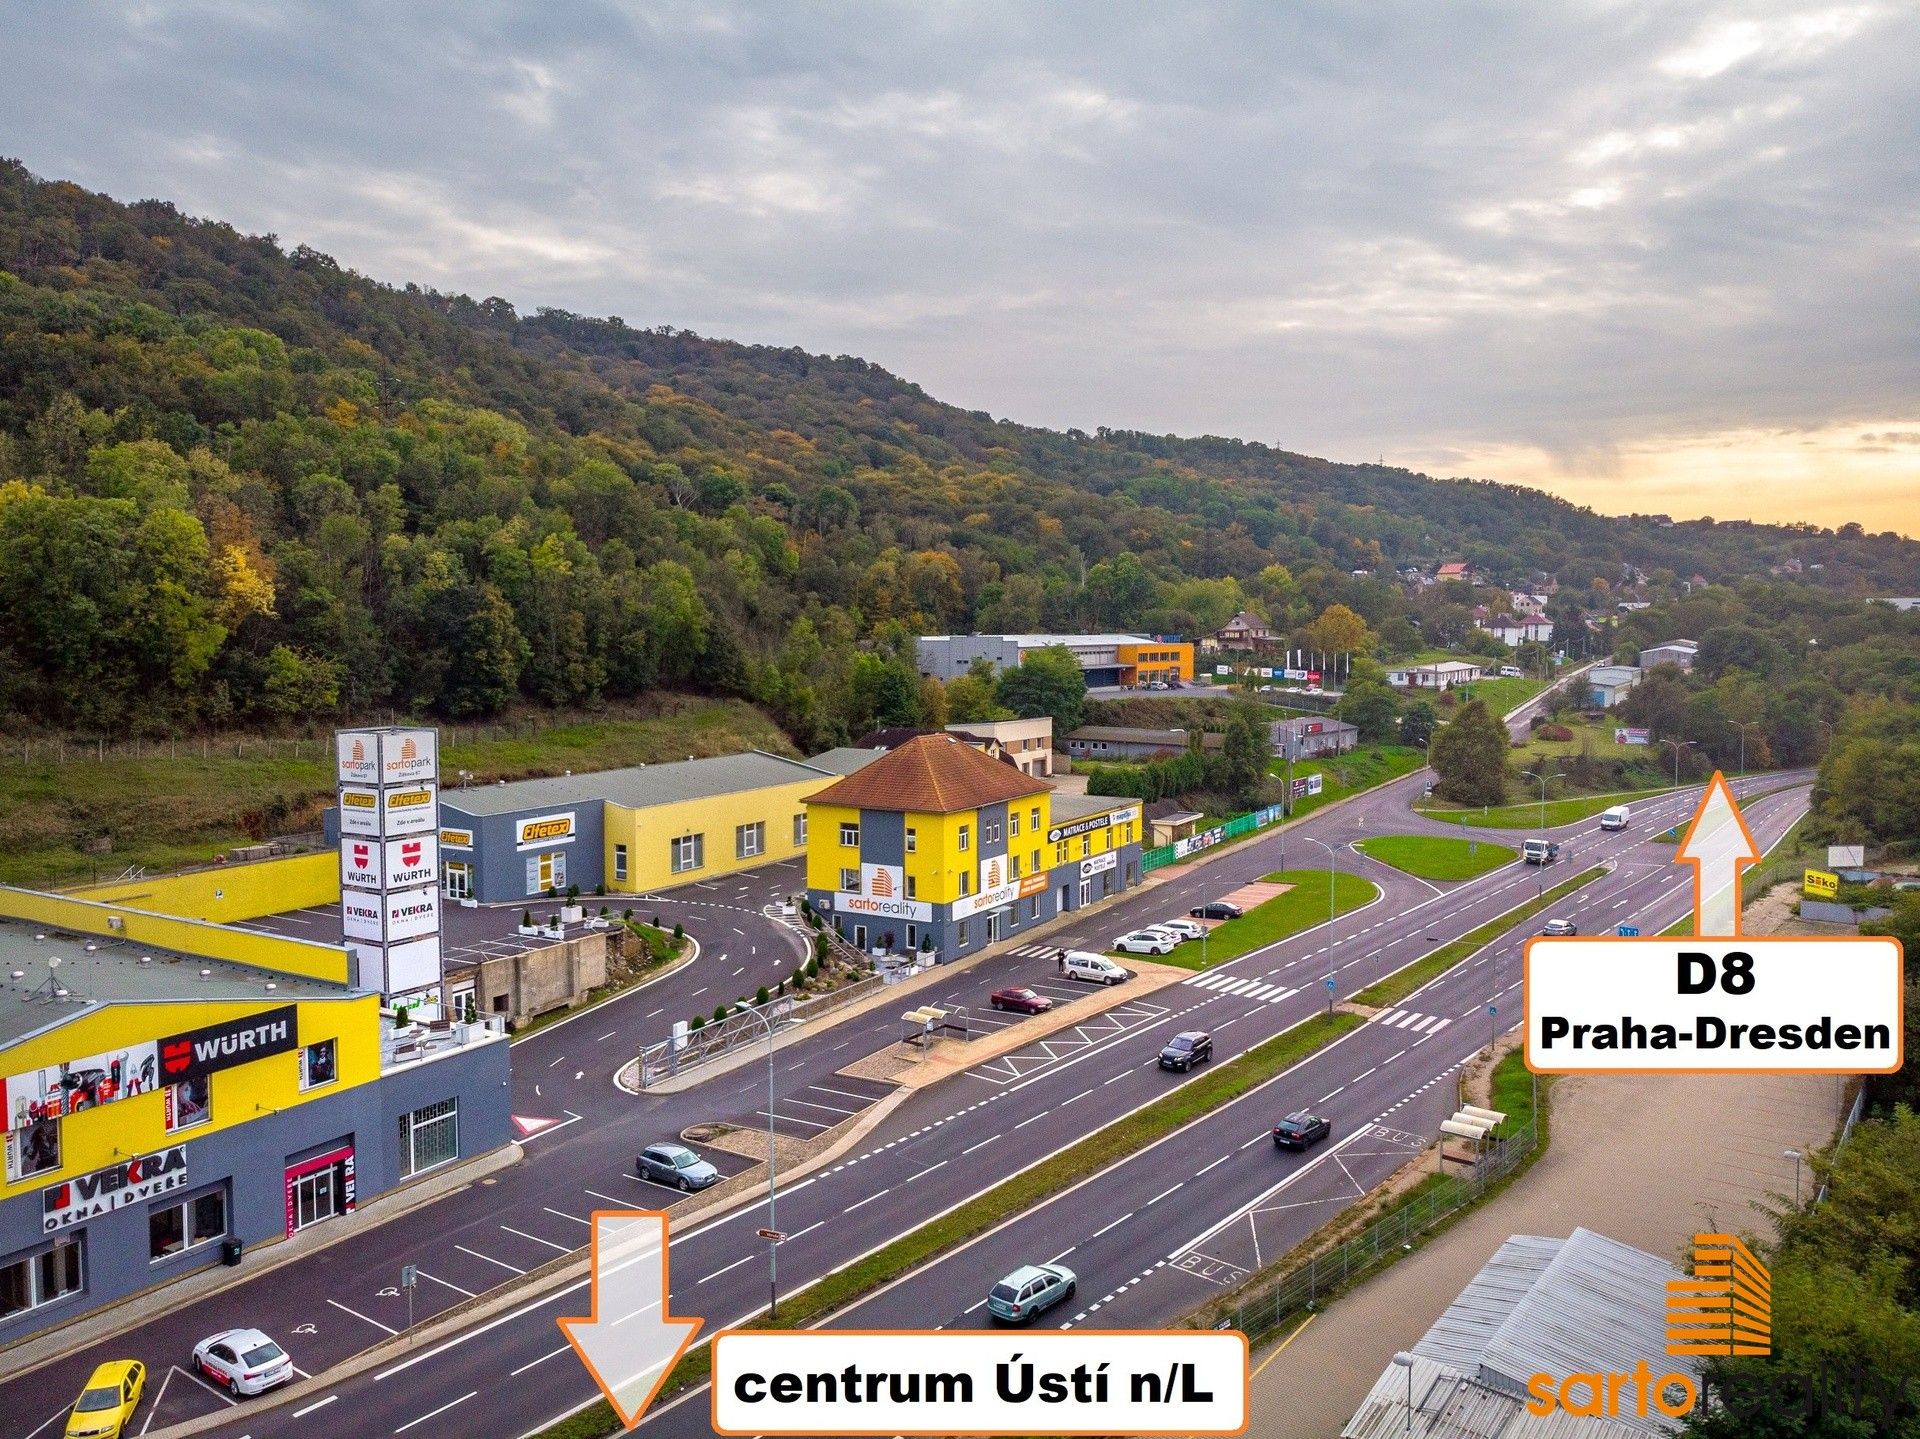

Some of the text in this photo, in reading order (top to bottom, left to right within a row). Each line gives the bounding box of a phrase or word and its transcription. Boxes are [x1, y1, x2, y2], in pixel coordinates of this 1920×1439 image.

[342, 760, 376, 771] sartopark
[387, 756, 431, 770] sartopark
[344, 793, 374, 807] Elfetex
[389, 791, 430, 807] Elfetex
[524, 819, 569, 840] Elfetex
[347, 871, 377, 884] WÜRTH
[393, 868, 431, 883] WÜRTH
[974, 886, 1014, 909] sartoreality
[353, 907, 378, 919] VEKRA
[401, 903, 433, 917] VEKRA
[848, 897, 917, 918] sartoreality
[195, 1020, 287, 1063] WÜRTH
[1375, 1125, 1429, 1148] BUS
[75, 1148, 186, 1201] VEKRA
[1180, 1255, 1244, 1286] BUS
